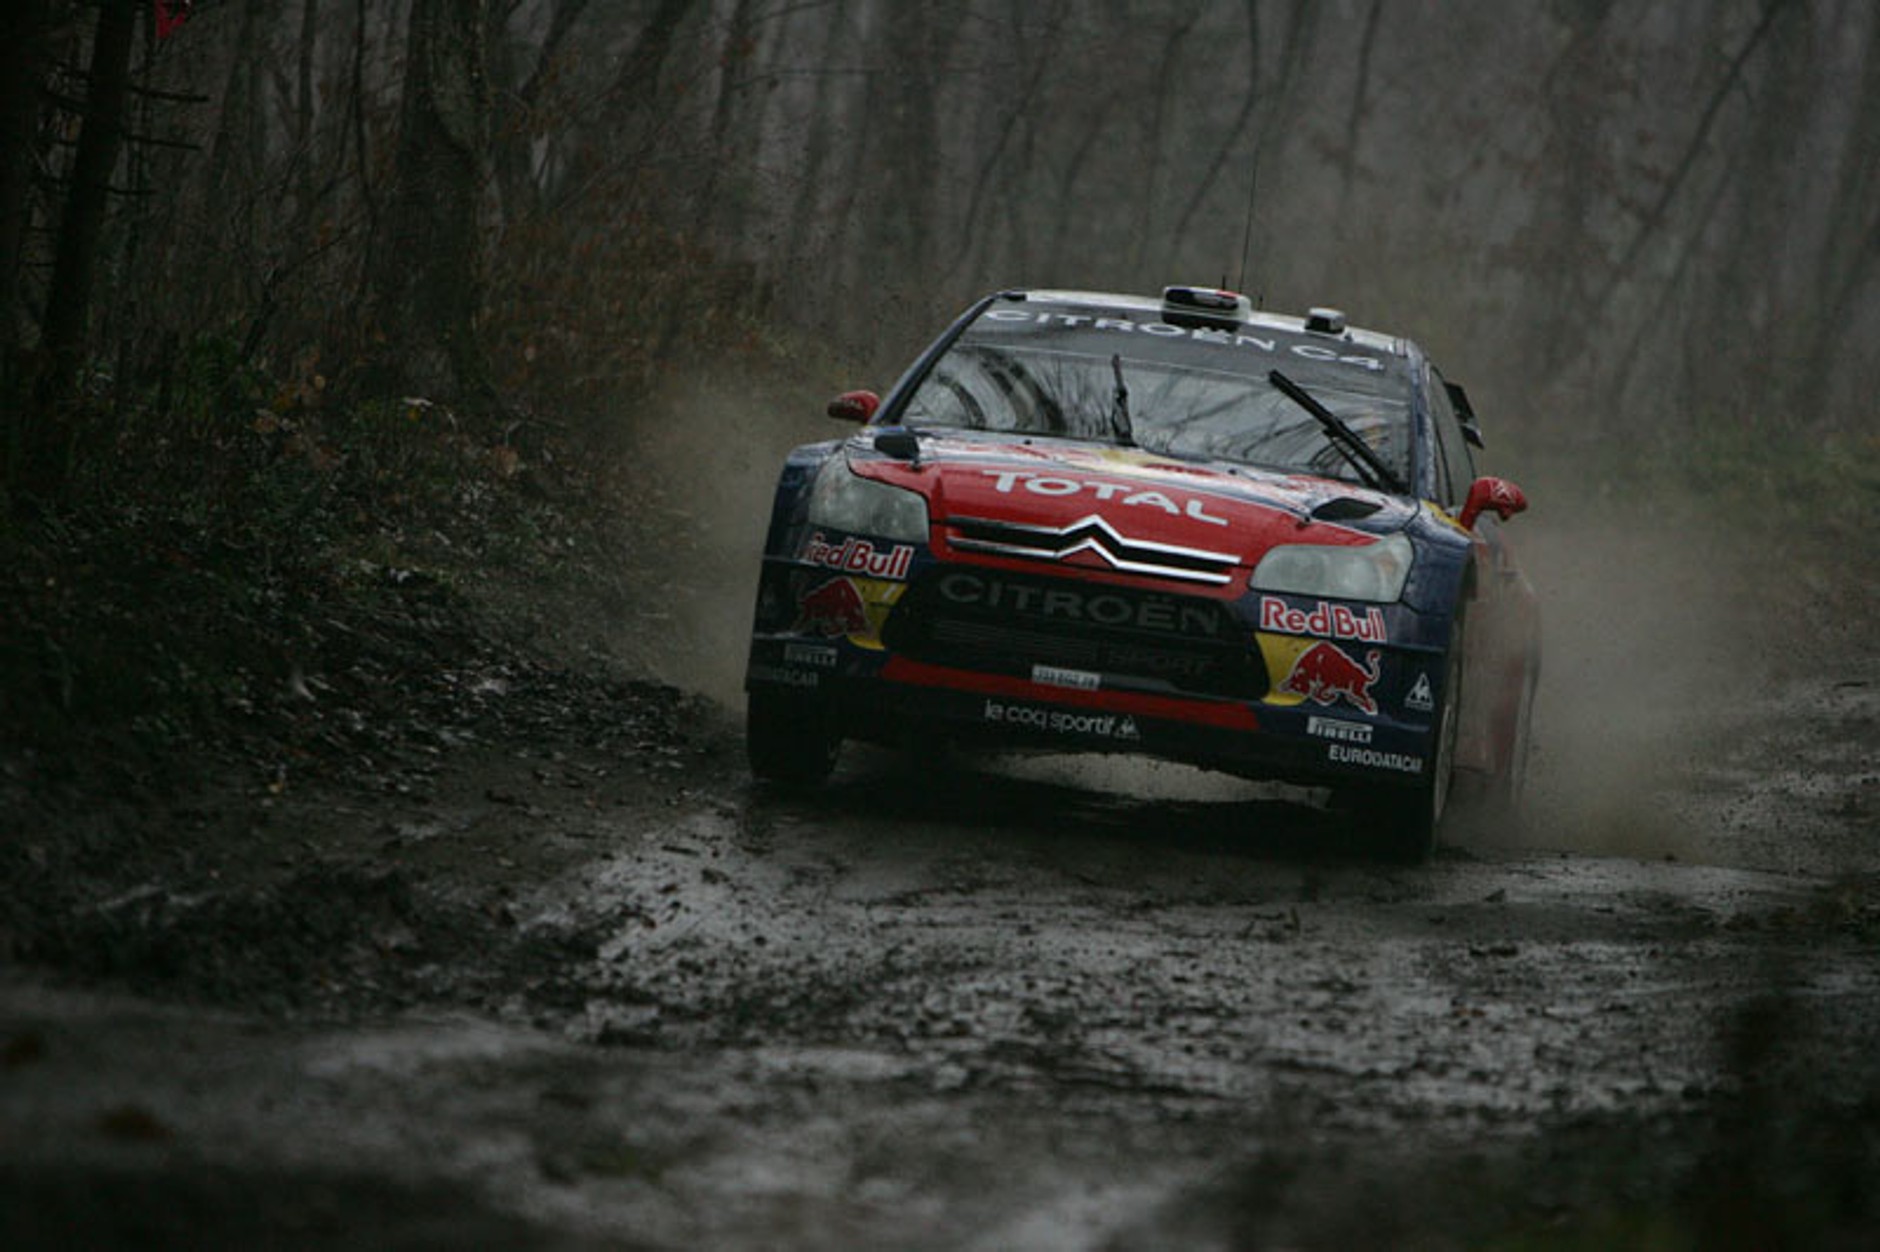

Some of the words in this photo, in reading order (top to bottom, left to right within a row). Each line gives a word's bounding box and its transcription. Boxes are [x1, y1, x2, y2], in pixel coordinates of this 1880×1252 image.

[1290, 343, 1386, 371] C4
[981, 469, 1230, 526] TOTAL
[847, 541, 915, 579] Bull
[939, 573, 1220, 634] CITROËN
[1260, 596, 1331, 637] Red
[1331, 604, 1389, 643] Bull
[984, 699, 1004, 720] le
[1005, 706, 1048, 730] coq
[1050, 711, 1116, 735] sportif
[1306, 716, 1374, 744] PIRELLI
